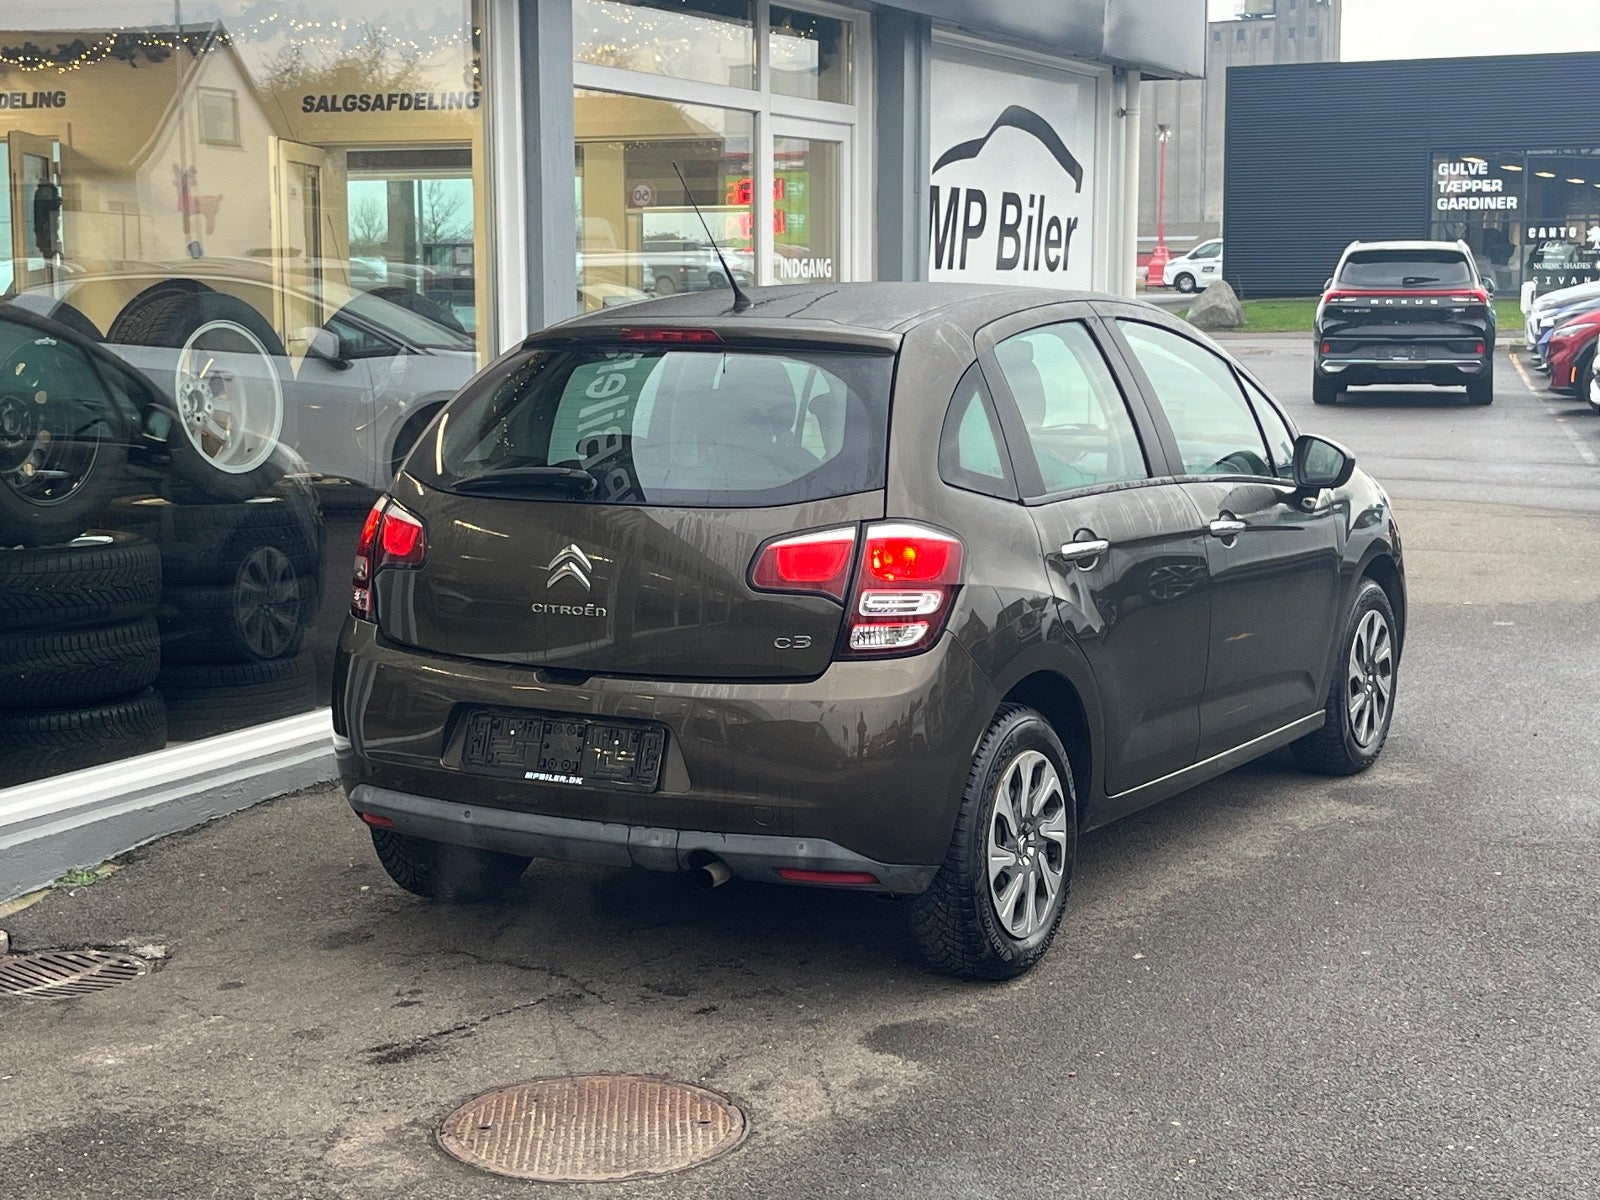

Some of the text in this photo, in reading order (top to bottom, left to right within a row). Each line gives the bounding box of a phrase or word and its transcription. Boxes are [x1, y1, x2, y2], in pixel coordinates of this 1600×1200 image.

[302, 91, 480, 113] SALGSAFDELING
[1438, 162, 1488, 175] GULVE
[1438, 179, 1502, 192] TÆPPER
[1437, 197, 1517, 210] GARDINER
[929, 185, 1079, 272] MP Biler
[1528, 227, 1577, 239] CANTO
[780, 258, 832, 279] INDGANG
[773, 635, 812, 649] C3
[524, 771, 584, 785] MPBILER.DK
